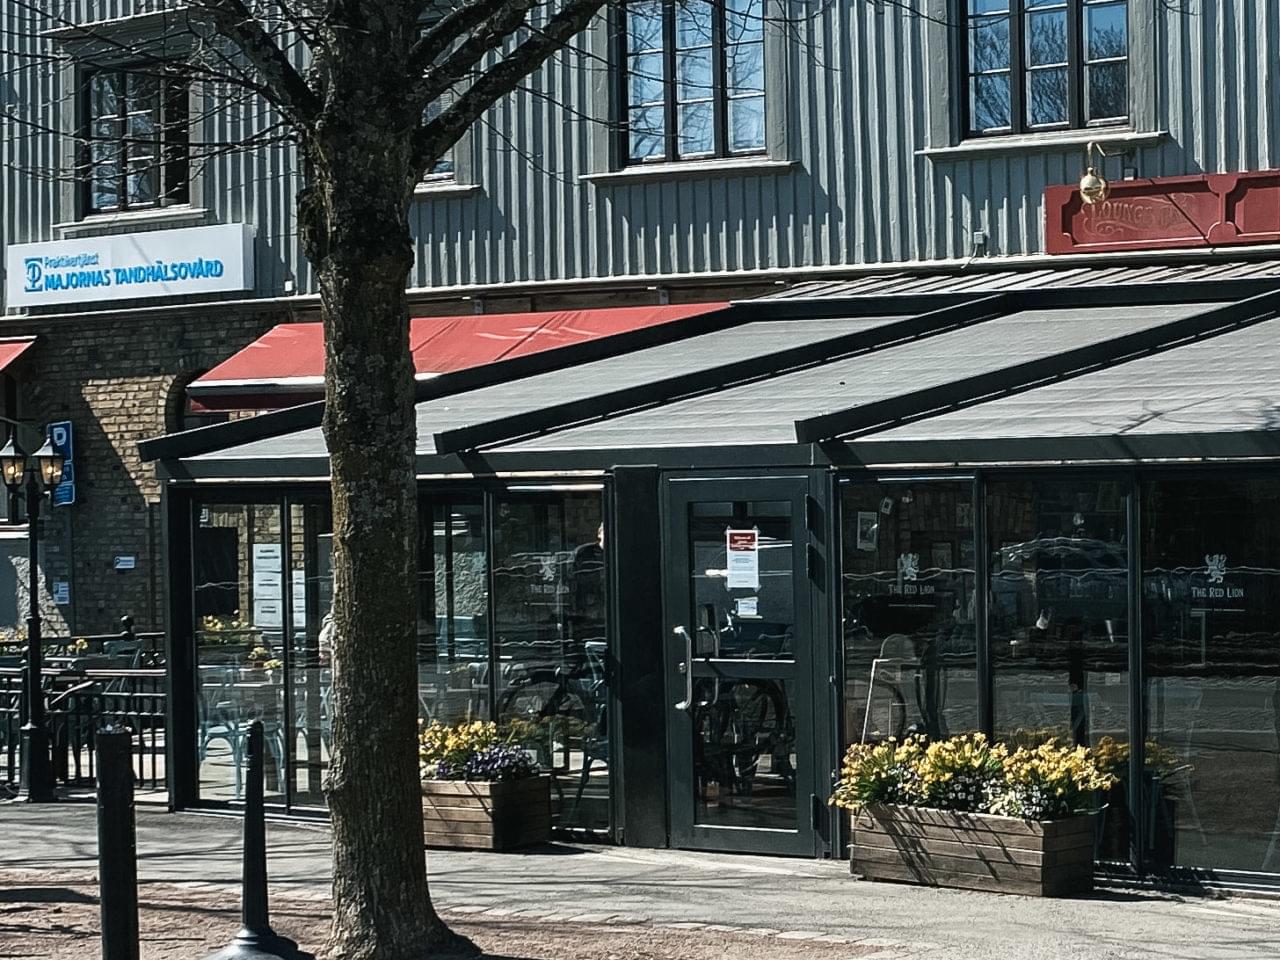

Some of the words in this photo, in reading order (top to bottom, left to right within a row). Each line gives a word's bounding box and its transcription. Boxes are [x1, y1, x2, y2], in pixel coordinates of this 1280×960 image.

[45, 269, 111, 291] MAJORNAS
[113, 257, 224, 285] TANDHÄLSOVÅRD
[1191, 586, 1207, 598] THE
[1209, 587, 1225, 598] RED
[1226, 587, 1244, 598] LION
